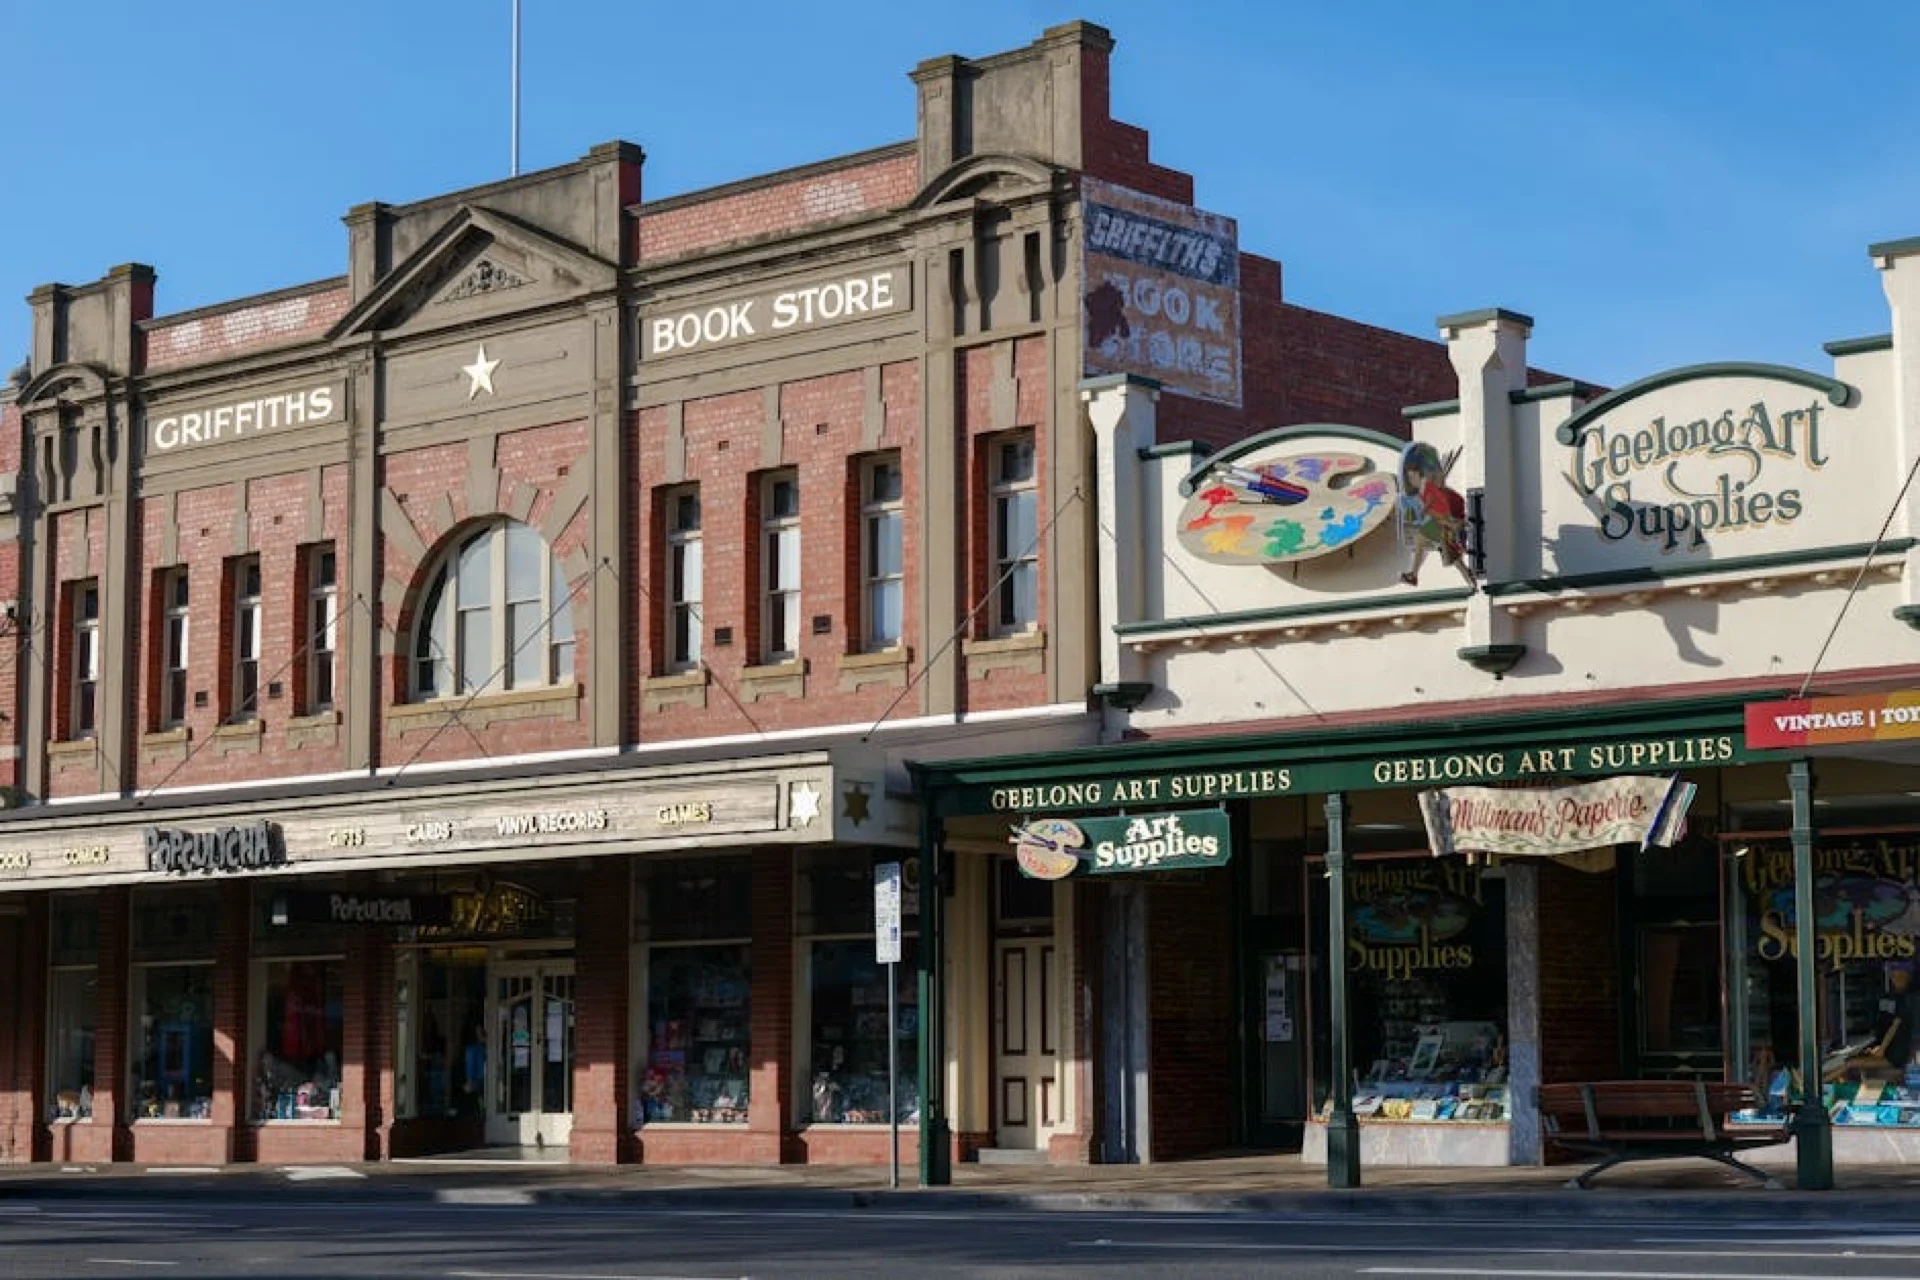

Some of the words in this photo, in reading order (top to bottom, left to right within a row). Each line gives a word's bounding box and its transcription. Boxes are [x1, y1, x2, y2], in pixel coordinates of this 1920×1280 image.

[1090, 211, 1221, 275] GRIFFITHS
[652, 300, 755, 353] BOOK
[771, 272, 893, 329] STORE
[154, 387, 335, 448] GRIFFITHS
[1574, 409, 1735, 496] Geelong
[1735, 399, 1829, 469] Art
[1600, 473, 1803, 551] Supplies
[1774, 709, 1864, 732] VINTAGE
[1373, 753, 1505, 784] GEELONG
[1517, 748, 1577, 774] ART
[1589, 736, 1734, 768] SUPPLIES
[992, 783, 1101, 811] GEELONG
[1112, 778, 1162, 802] ART
[1171, 769, 1292, 798] SUPPLIES
[407, 820, 453, 842] CARDS
[496, 813, 540, 835] VINYL
[541, 808, 609, 832] RECORDS
[658, 803, 713, 824] GAMES
[1126, 813, 1181, 845] Art
[1451, 799, 1550, 838] Millman's
[1096, 829, 1218, 868] Supplies
